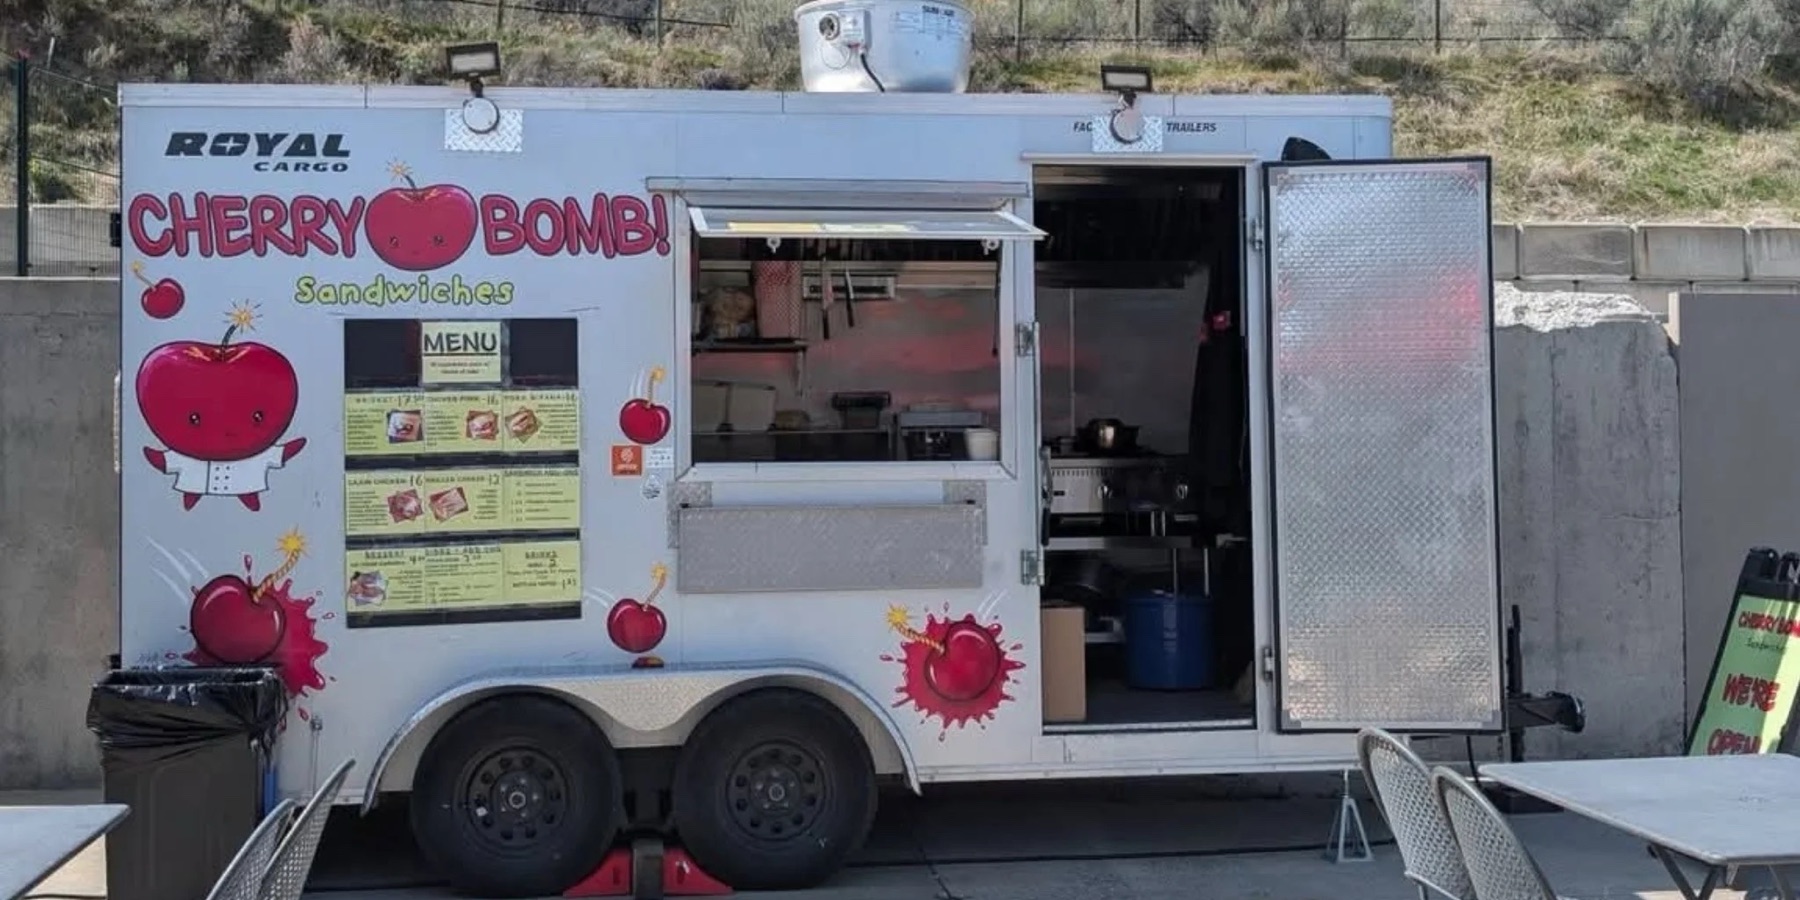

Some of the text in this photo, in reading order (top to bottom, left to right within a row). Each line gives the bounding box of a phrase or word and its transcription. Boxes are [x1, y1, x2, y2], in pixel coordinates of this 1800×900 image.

[1166, 122, 1217, 133] TRAILERS
[164, 132, 351, 158] ROYAL
[253, 161, 349, 172] CARGO
[128, 191, 671, 259] CHERRY BOMB!
[295, 274, 515, 305] Sandwiches
[424, 331, 497, 354] MENU
[1738, 611, 1778, 632] CHERRY
[1722, 673, 1780, 712] WE'RE
